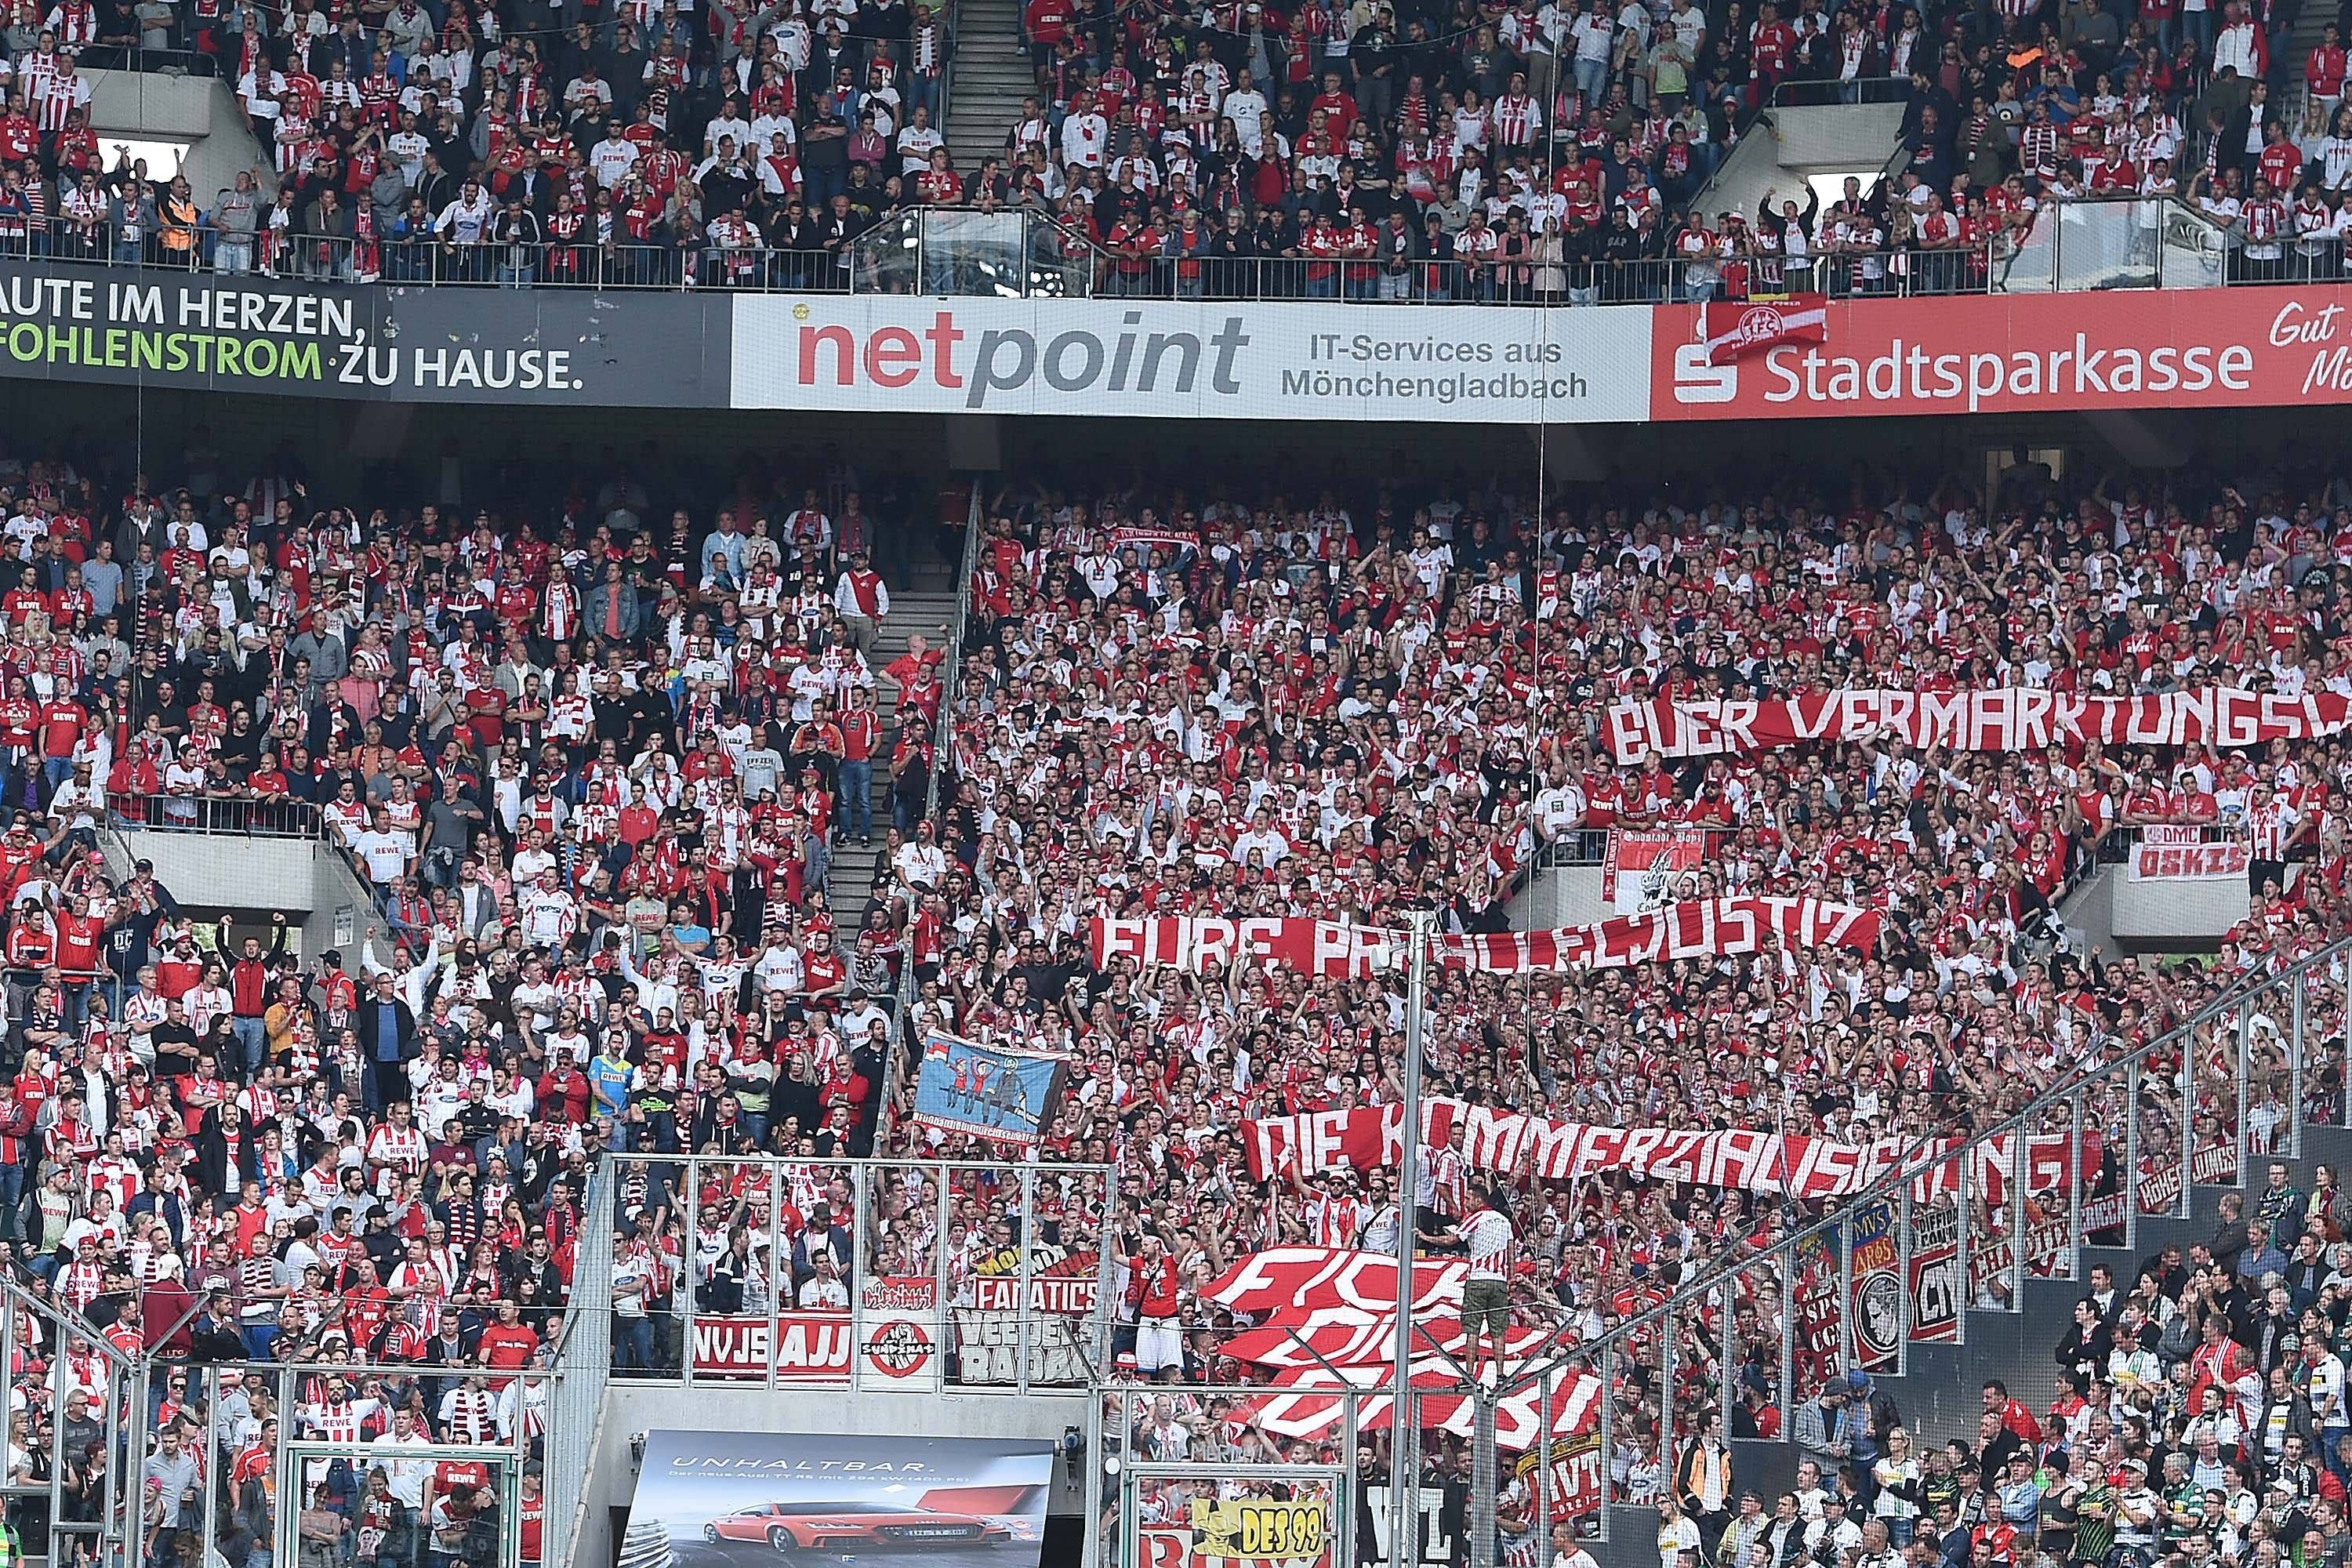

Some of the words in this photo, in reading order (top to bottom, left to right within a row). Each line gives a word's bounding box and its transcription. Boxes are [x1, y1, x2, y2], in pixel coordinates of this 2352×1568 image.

[109, 283, 164, 324] IM
[180, 289, 366, 345] HERZEN,
[2270, 301, 2344, 347] Gut
[1310, 334, 1492, 362] IT-Services
[1504, 340, 1562, 363] aus
[798, 310, 1250, 408] netpoint
[339, 345, 397, 385] ZU
[416, 348, 583, 390] HAUSE.
[1764, 332, 2253, 412] Stadtsparkasse
[1281, 369, 1588, 404] Mönchengladbach
[17, 601, 39, 610] REWE
[802, 680, 823, 688] REWE
[1610, 700, 1759, 766] EUER
[1592, 800, 1613, 811] REWE
[2164, 827, 2197, 842] DMC
[635, 913, 657, 922] REWE
[1102, 917, 1282, 976] EURE
[770, 967, 795, 976] REWE
[603, 1073, 624, 1082] REWE
[1257, 1109, 1350, 1177] DIE
[390, 1147, 415, 1156] REWE
[42, 1208, 67, 1218] REWE
[76, 1281, 100, 1290] REWE
[322, 1419, 352, 1428] REWE
[673, 1457, 935, 1473] UNHALTBAR.
[447, 1474, 476, 1485] REWE
[1241, 1508, 1290, 1554] DES
[1292, 1507, 1322, 1553] 99
